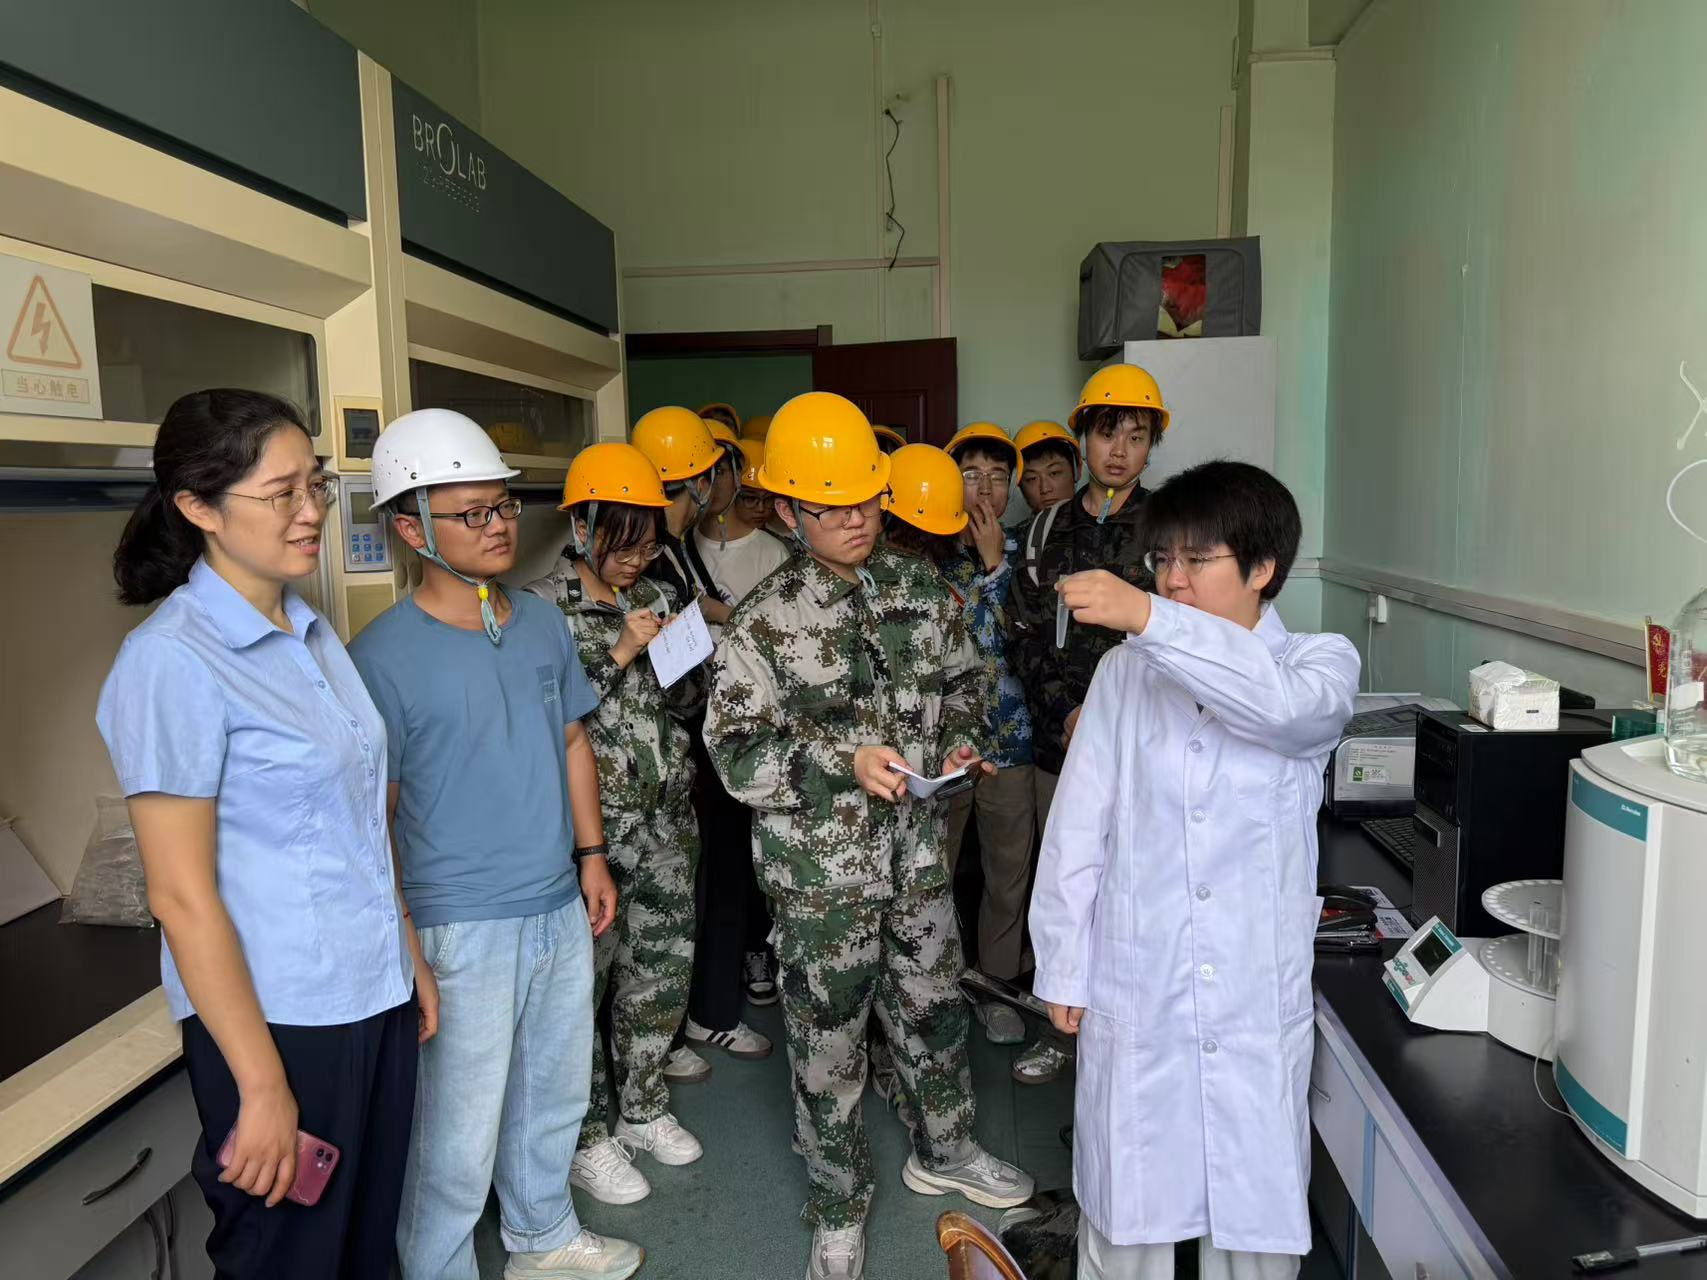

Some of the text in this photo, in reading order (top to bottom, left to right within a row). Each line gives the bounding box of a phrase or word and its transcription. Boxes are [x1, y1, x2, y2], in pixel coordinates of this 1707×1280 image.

[412, 113, 487, 191] BROLAB
[16, 375, 80, 399] 当心触电
